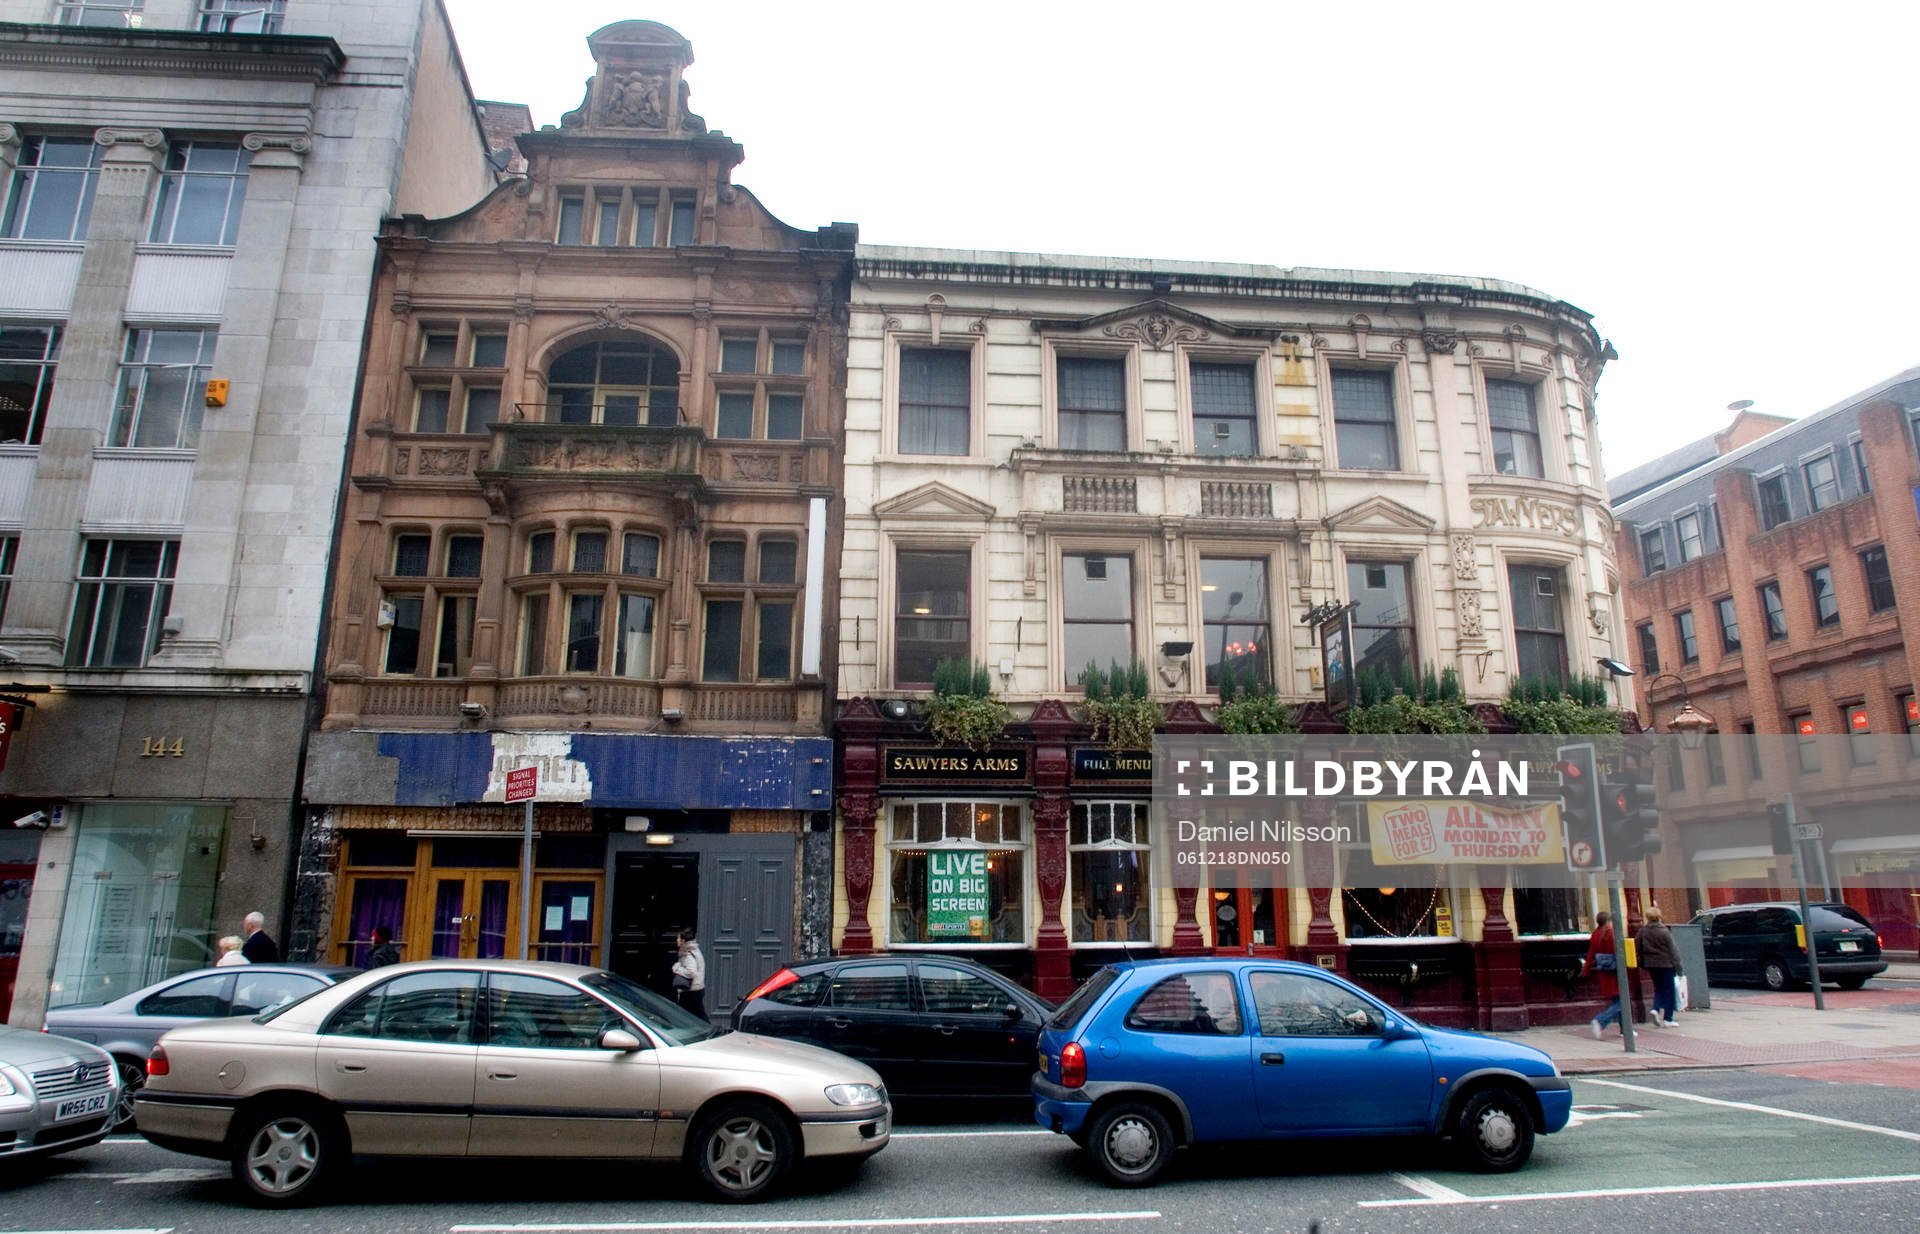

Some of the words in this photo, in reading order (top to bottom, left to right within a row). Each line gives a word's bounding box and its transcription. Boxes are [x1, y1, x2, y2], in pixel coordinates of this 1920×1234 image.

[1470, 495, 1580, 537] SAWYERS
[140, 736, 185, 757] 144
[893, 757, 969, 771] SAWYERS
[972, 758, 1019, 771] ARMS
[1083, 759, 1110, 771] FULL
[1115, 759, 1151, 771] MENU
[512, 770, 531, 781] SIGNAL
[507, 778, 535, 790] PRIORITIES
[508, 788, 534, 799] CHANGED
[1387, 809, 1426, 829] TWO
[1445, 806, 1488, 829] ALL
[1492, 809, 1543, 830] DAY
[1392, 822, 1431, 843] MEALS
[1443, 829, 1521, 844] MONDAY
[1526, 830, 1547, 844] TO
[1395, 838, 1420, 857] FOR
[1420, 836, 1433, 852] £7
[1451, 844, 1541, 858] THURSDAY
[931, 853, 985, 876] LIVE
[931, 879, 953, 894] ON
[960, 879, 985, 894] BIG
[932, 897, 985, 912] SCREEN
[60, 1100, 86, 1117] WR55
[87, 1095, 106, 1112] CRZ
